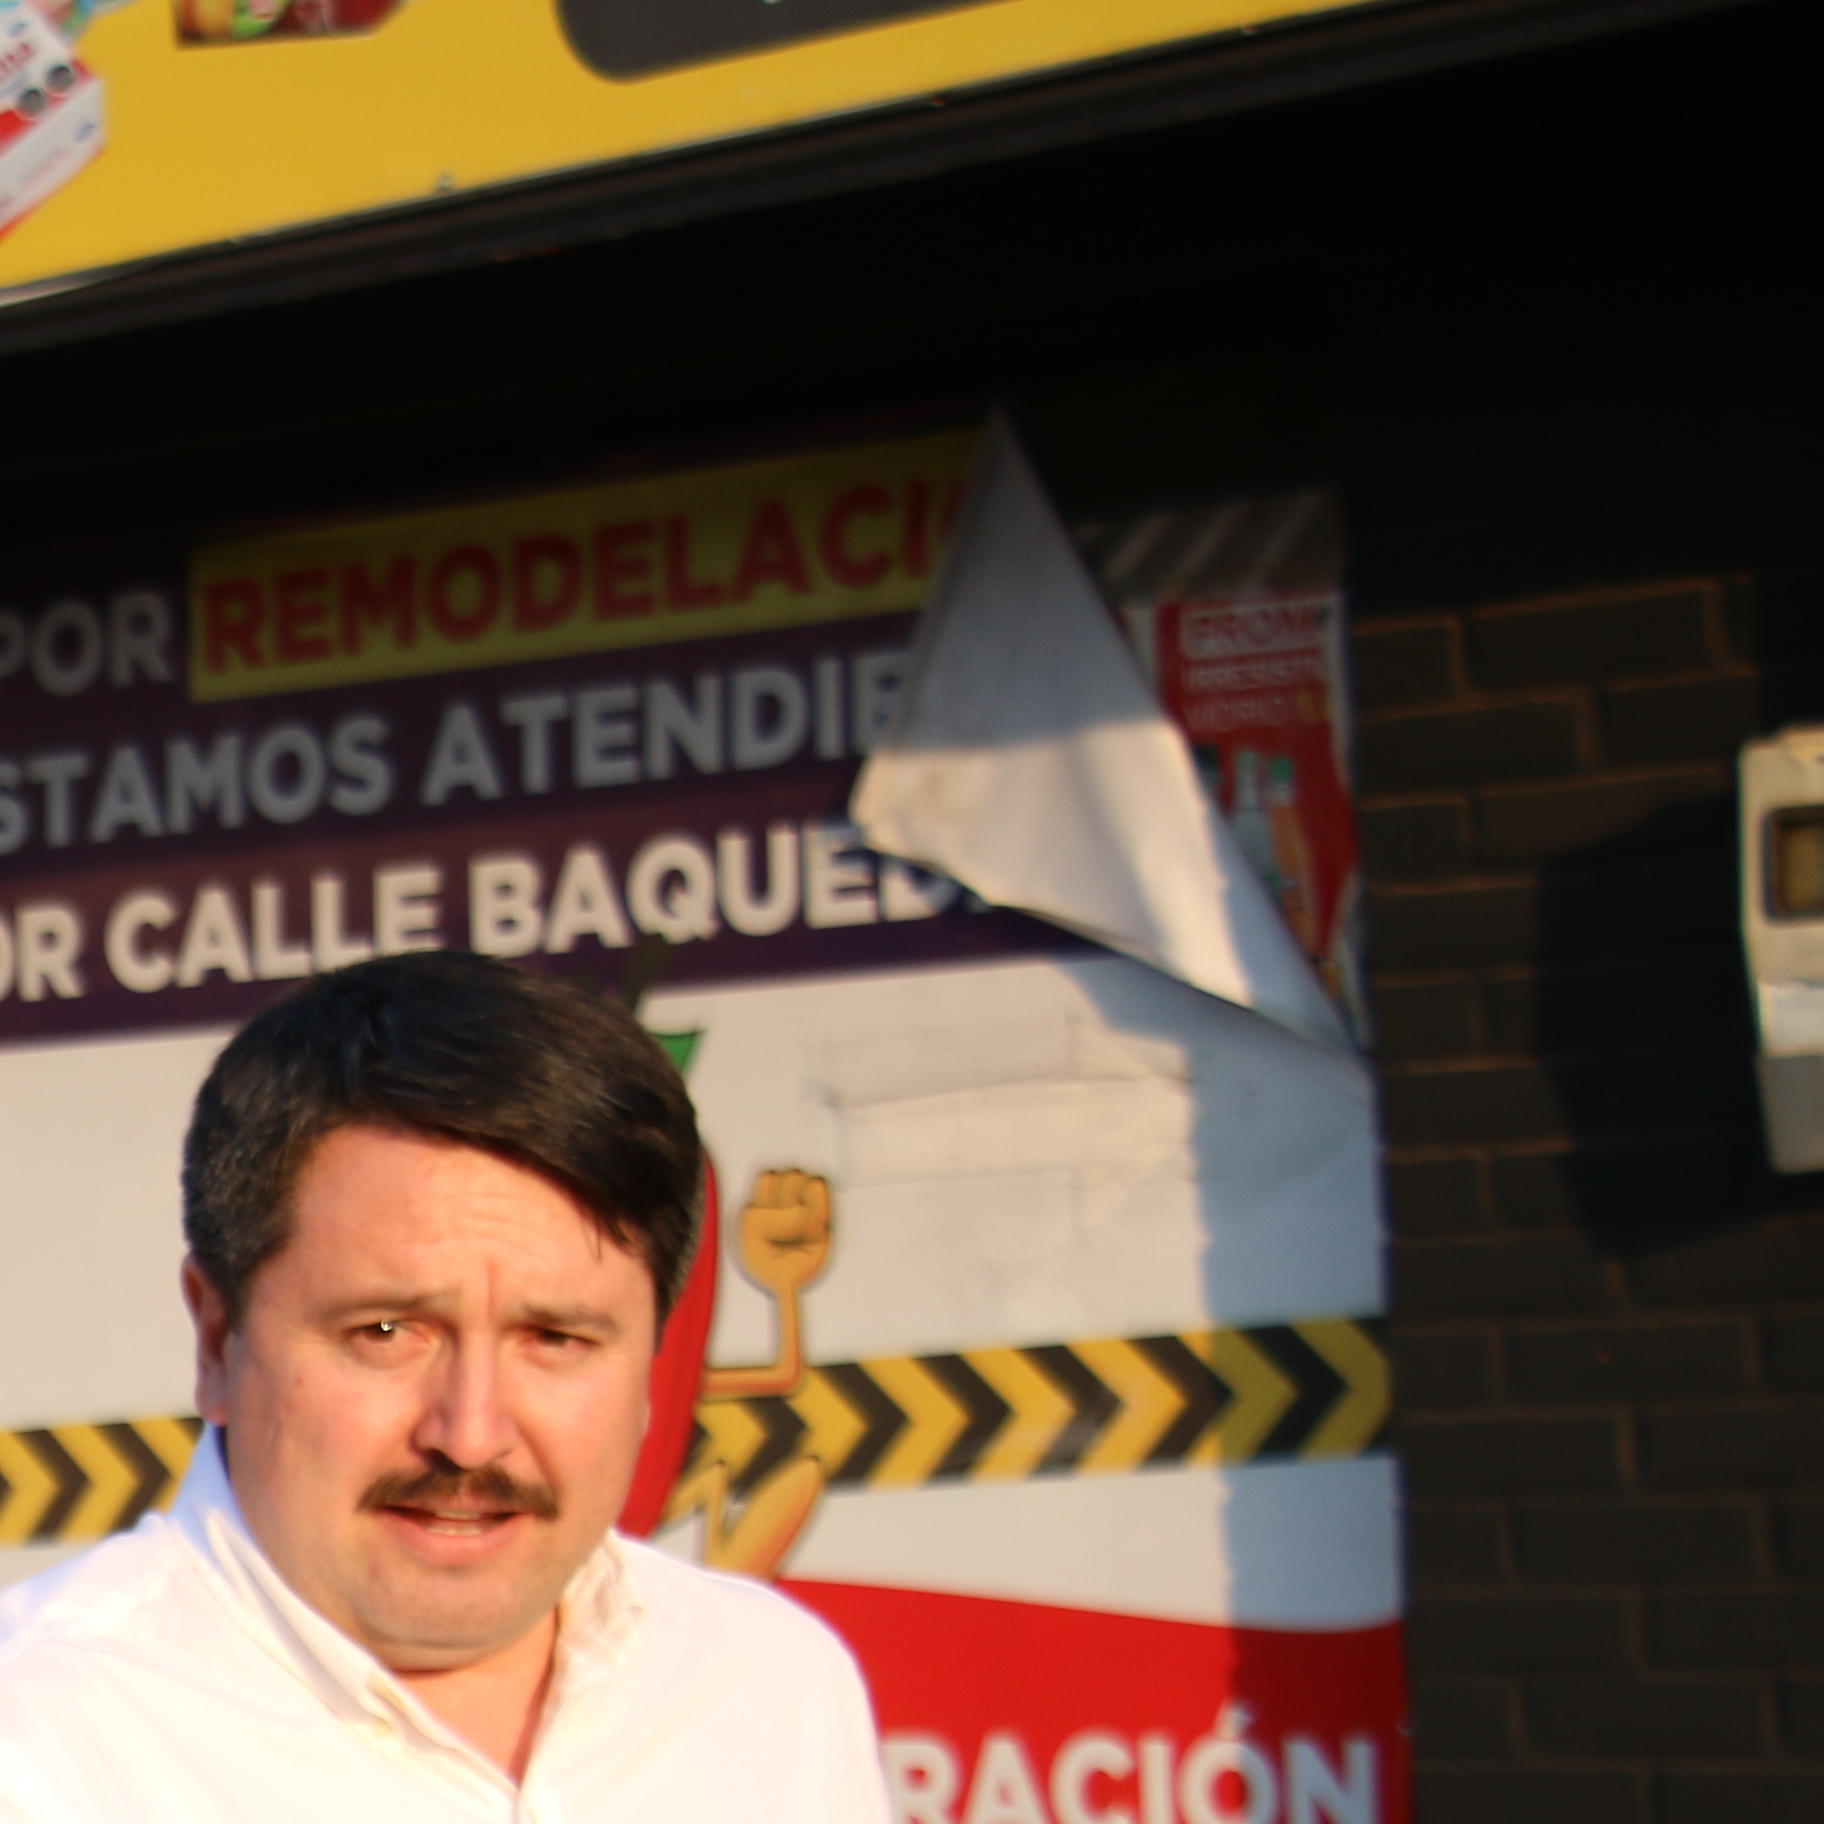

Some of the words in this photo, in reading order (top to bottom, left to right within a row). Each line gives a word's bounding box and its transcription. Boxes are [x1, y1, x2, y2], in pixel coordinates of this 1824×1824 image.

[204, 478, 968, 676] REMODELACI
[419, 645, 912, 806] ATENDIE
[103, 858, 449, 994] CALLE
